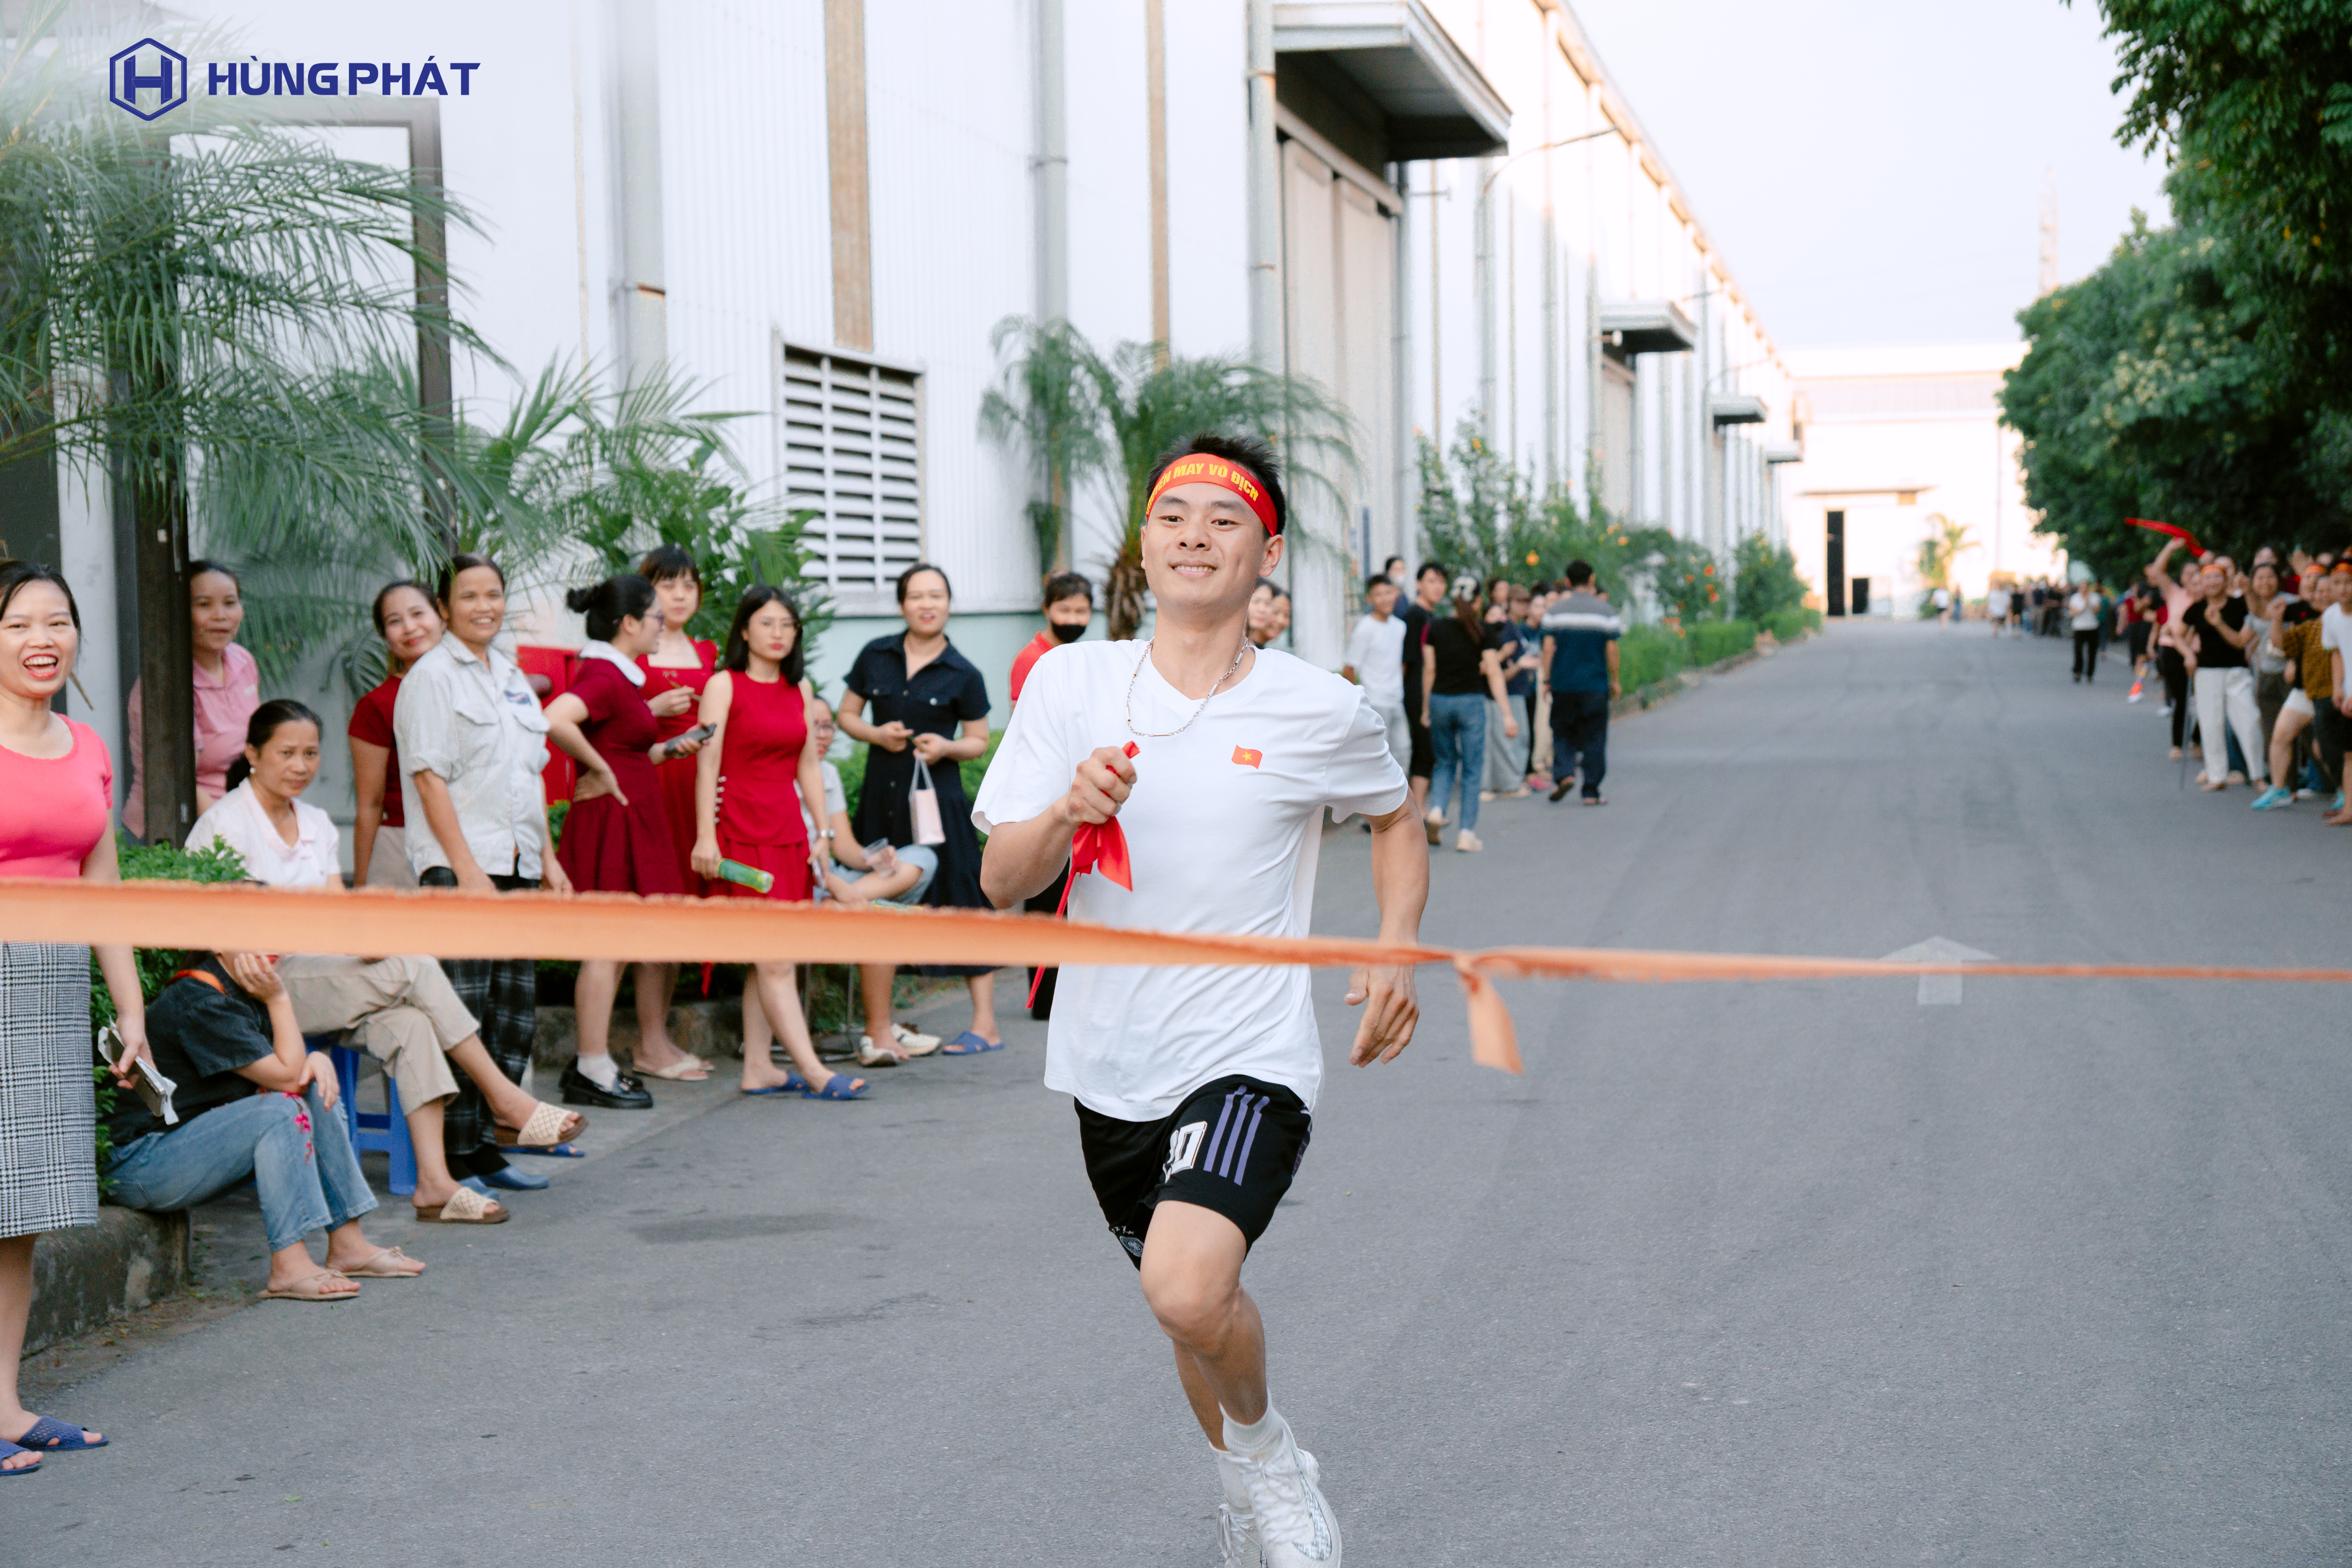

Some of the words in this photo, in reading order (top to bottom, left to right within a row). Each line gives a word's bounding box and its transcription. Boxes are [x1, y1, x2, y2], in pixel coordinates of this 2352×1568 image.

[1173, 463, 1205, 479] MAY
[1209, 463, 1228, 478] VÔ
[1231, 471, 1259, 502] ĐỊCH
